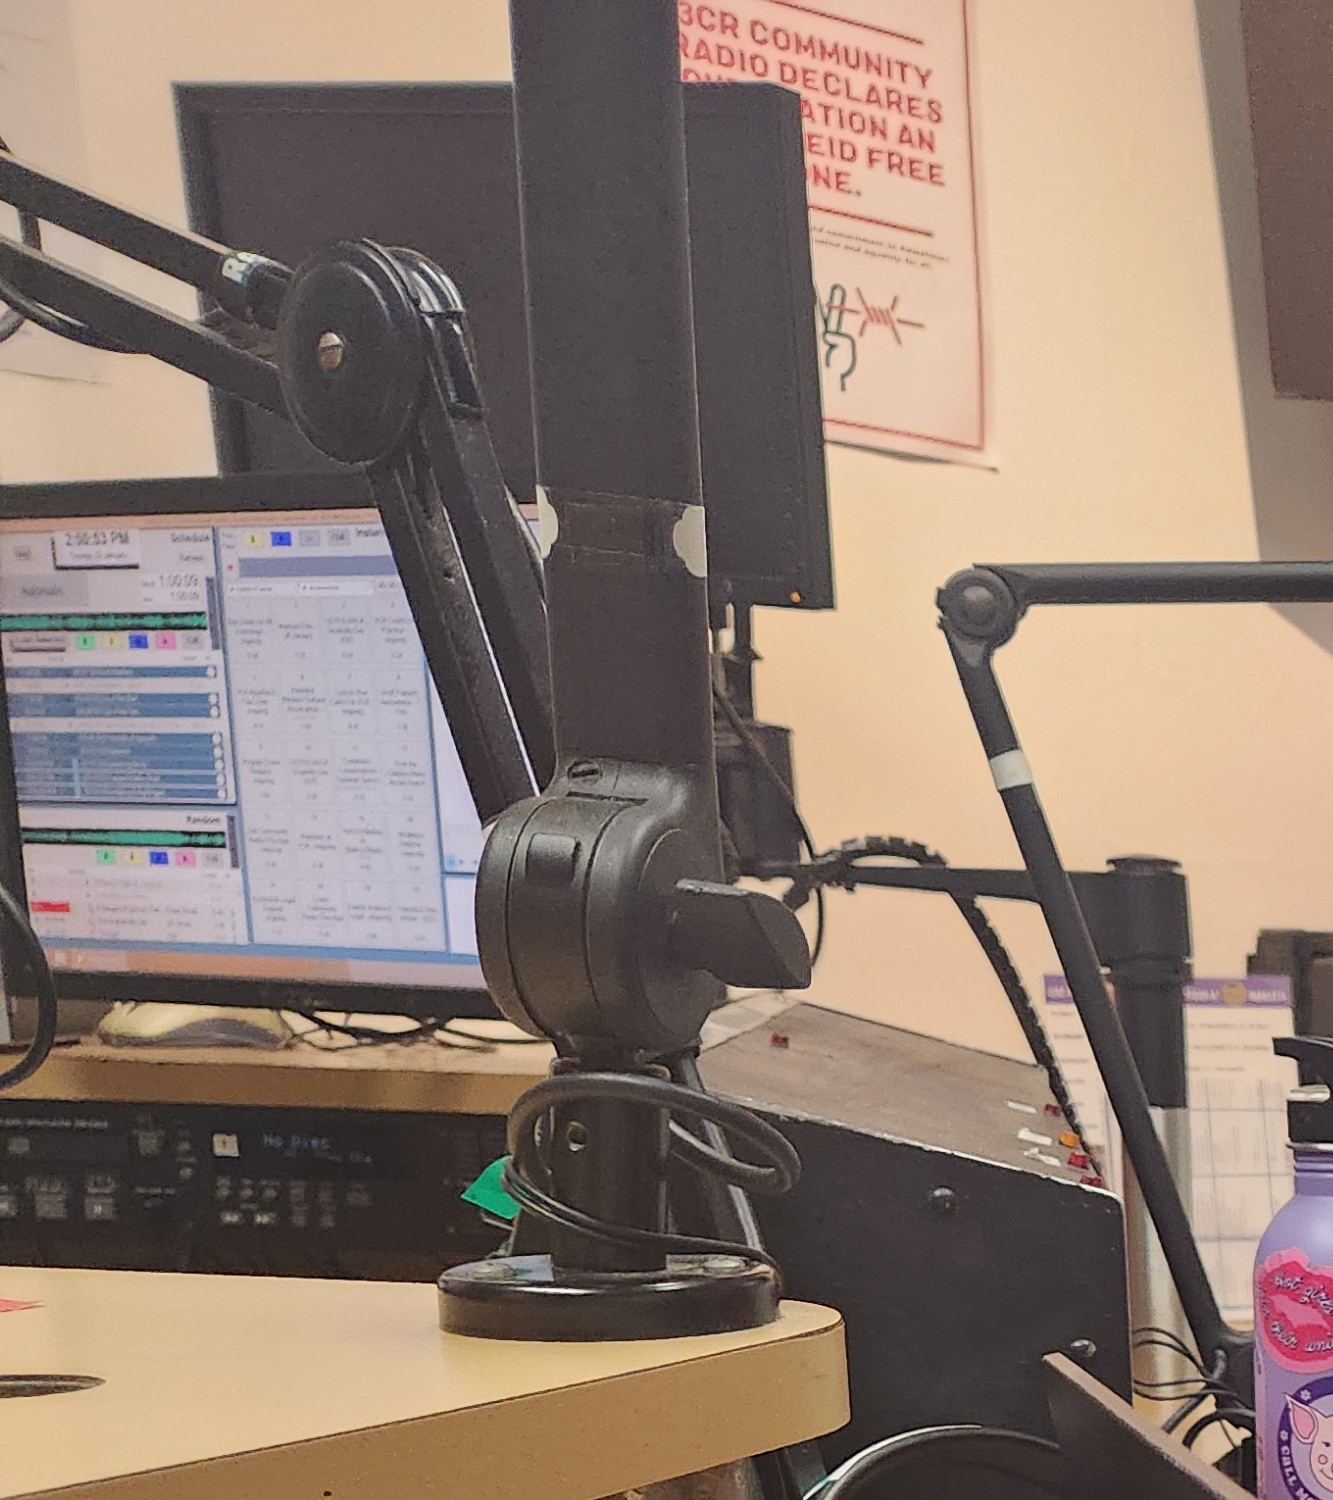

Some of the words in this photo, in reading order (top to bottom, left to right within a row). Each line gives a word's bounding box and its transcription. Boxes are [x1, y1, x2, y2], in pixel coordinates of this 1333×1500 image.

[679, 1, 739, 39] 3CR
[750, 19, 933, 88] COMMUNITY
[680, 33, 768, 77] RADIO
[780, 59, 943, 124] DECLARES
[801, 98, 888, 140] ATION
[899, 125, 935, 153] AN
[868, 148, 946, 187] FREE
